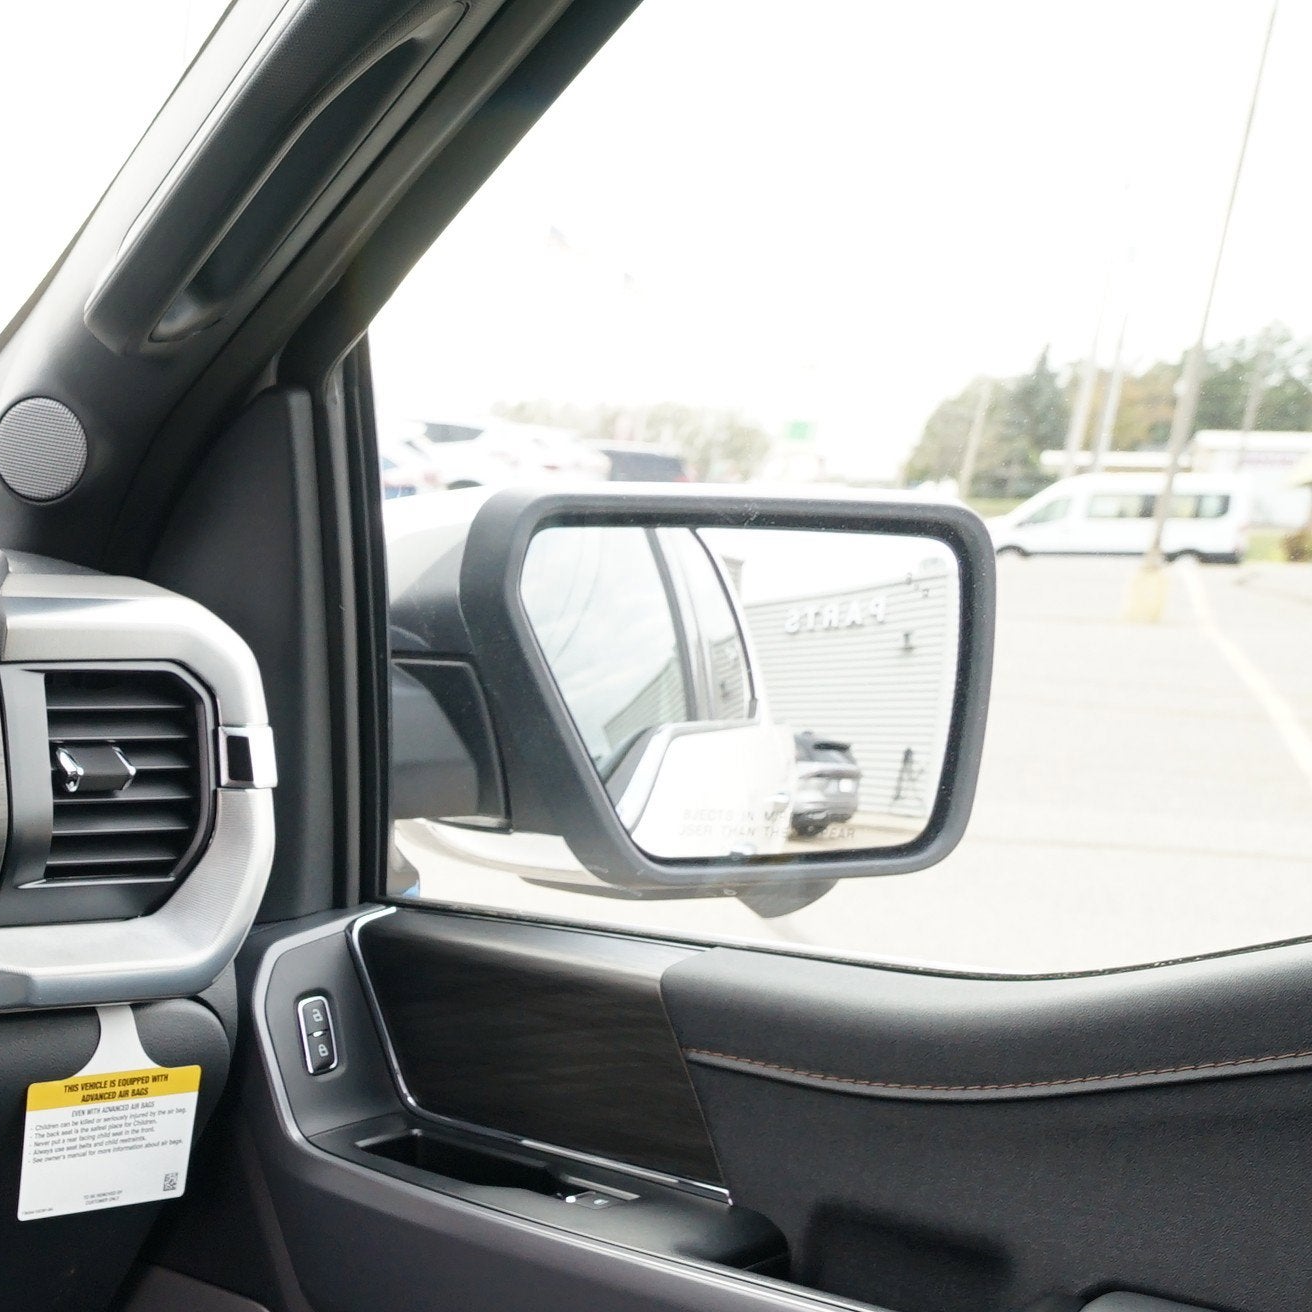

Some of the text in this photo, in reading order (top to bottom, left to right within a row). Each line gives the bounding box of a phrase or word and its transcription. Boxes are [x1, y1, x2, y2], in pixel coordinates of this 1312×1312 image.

[64, 1074, 169, 1093] THIS VEHICLE IS EQUIPPED WITH
[81, 1087, 149, 1103] ADVANCED AIR BAGS
[87, 1107, 101, 1115] WITH
[102, 1103, 129, 1113] ADVANCED
[131, 1102, 139, 1110] AIR
[141, 1101, 155, 1109] BAGS
[35, 1123, 59, 1131] Children
